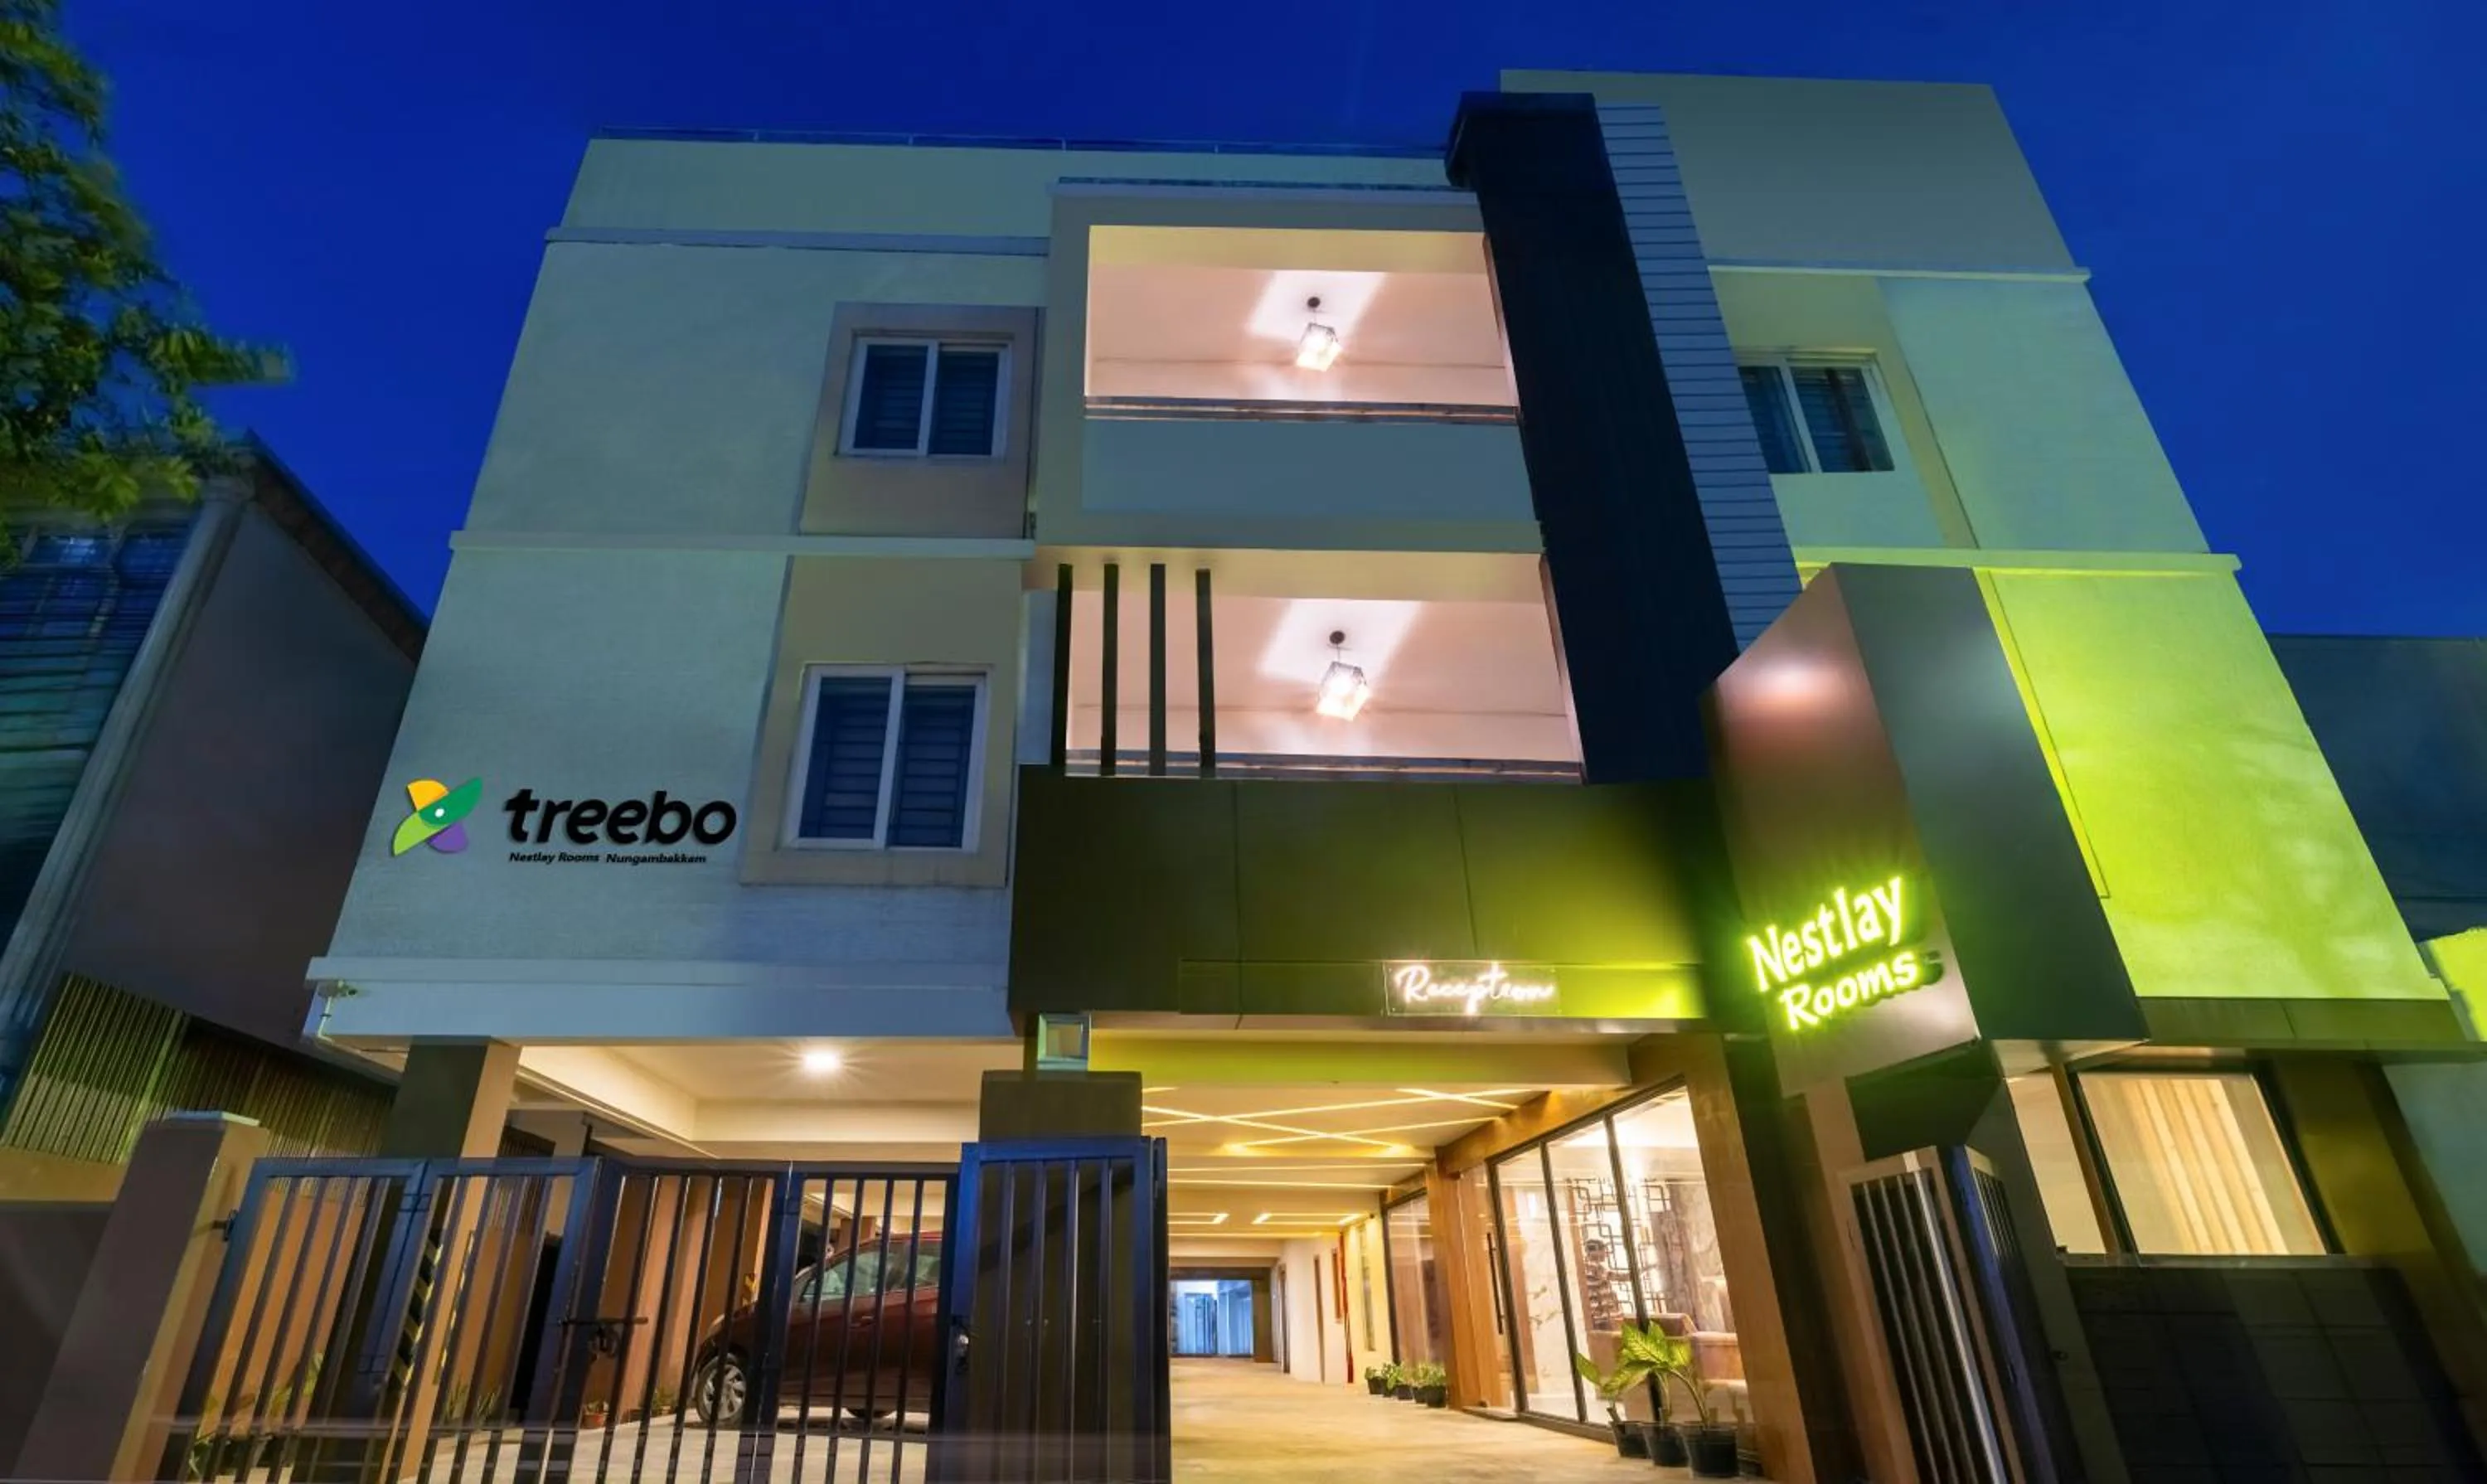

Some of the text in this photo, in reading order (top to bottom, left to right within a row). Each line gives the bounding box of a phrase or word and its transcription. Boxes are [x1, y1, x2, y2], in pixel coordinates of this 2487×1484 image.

[502, 788, 737, 846] treebo
[509, 851, 706, 866] Nestlay Rooms Nungambakkam
[1746, 875, 1903, 992] Nestlay
[1779, 949, 1918, 1031] Rooms
